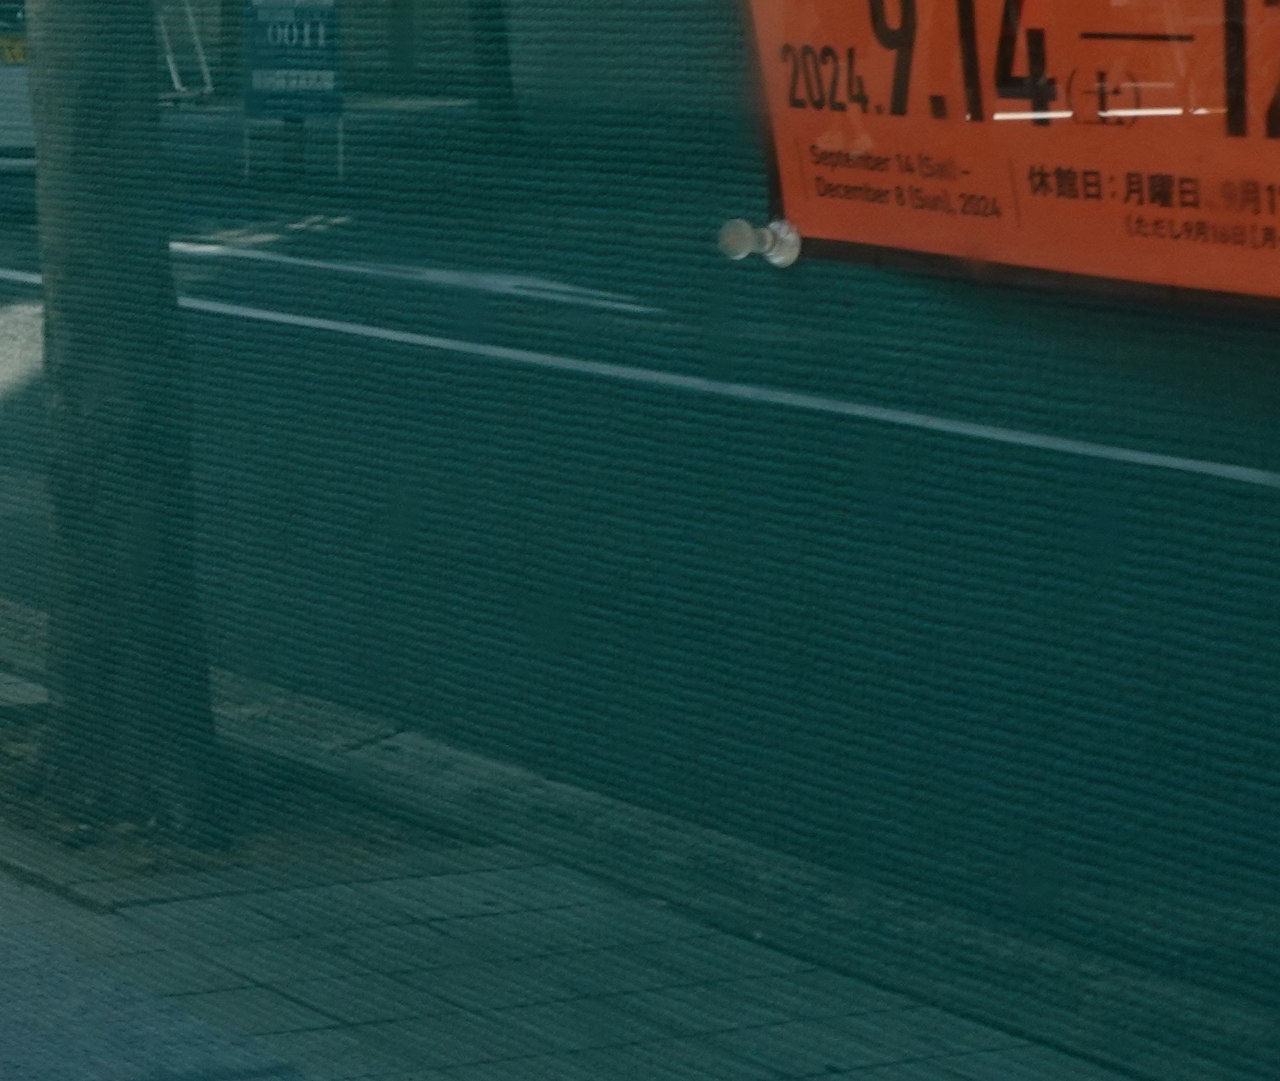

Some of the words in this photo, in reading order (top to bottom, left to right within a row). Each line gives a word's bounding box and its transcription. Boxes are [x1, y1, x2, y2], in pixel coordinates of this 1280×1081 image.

[809, 144, 892, 172] September
[814, 176, 891, 205] December
[959, 192, 1003, 218] 2024
